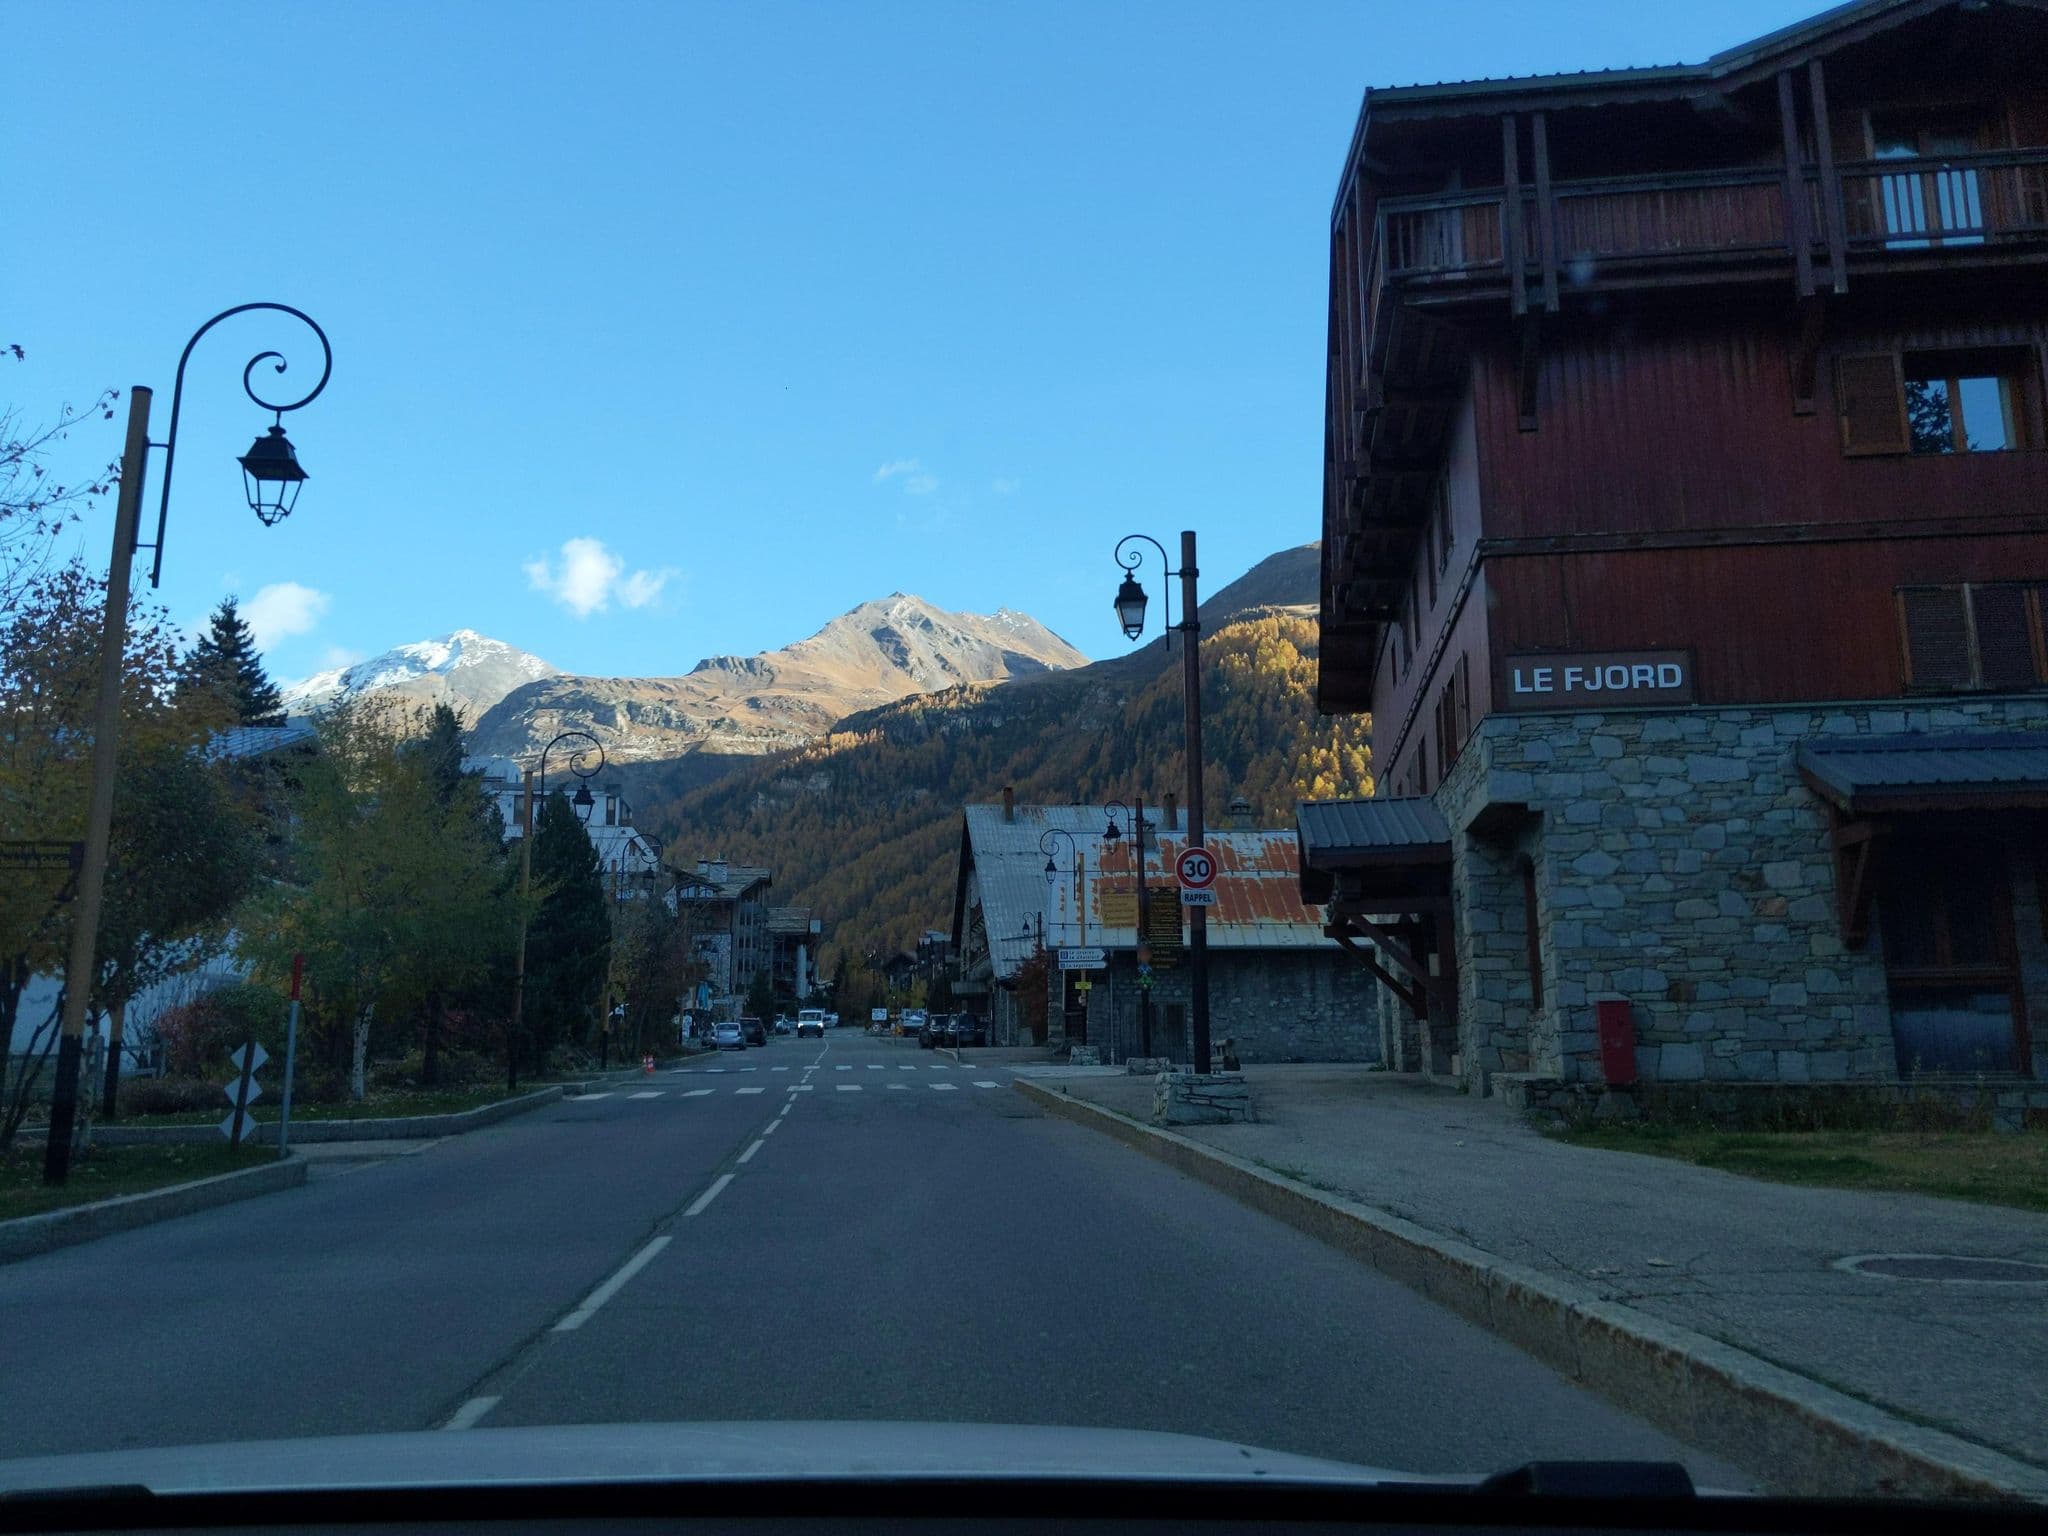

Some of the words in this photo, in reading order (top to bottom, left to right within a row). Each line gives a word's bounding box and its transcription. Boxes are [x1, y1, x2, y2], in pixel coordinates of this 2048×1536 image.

[1514, 668, 1553, 692] LE
[1564, 664, 1682, 691] FJORD
[1184, 860, 1210, 877] 30
[1184, 893, 1212, 903] RAPPEL
